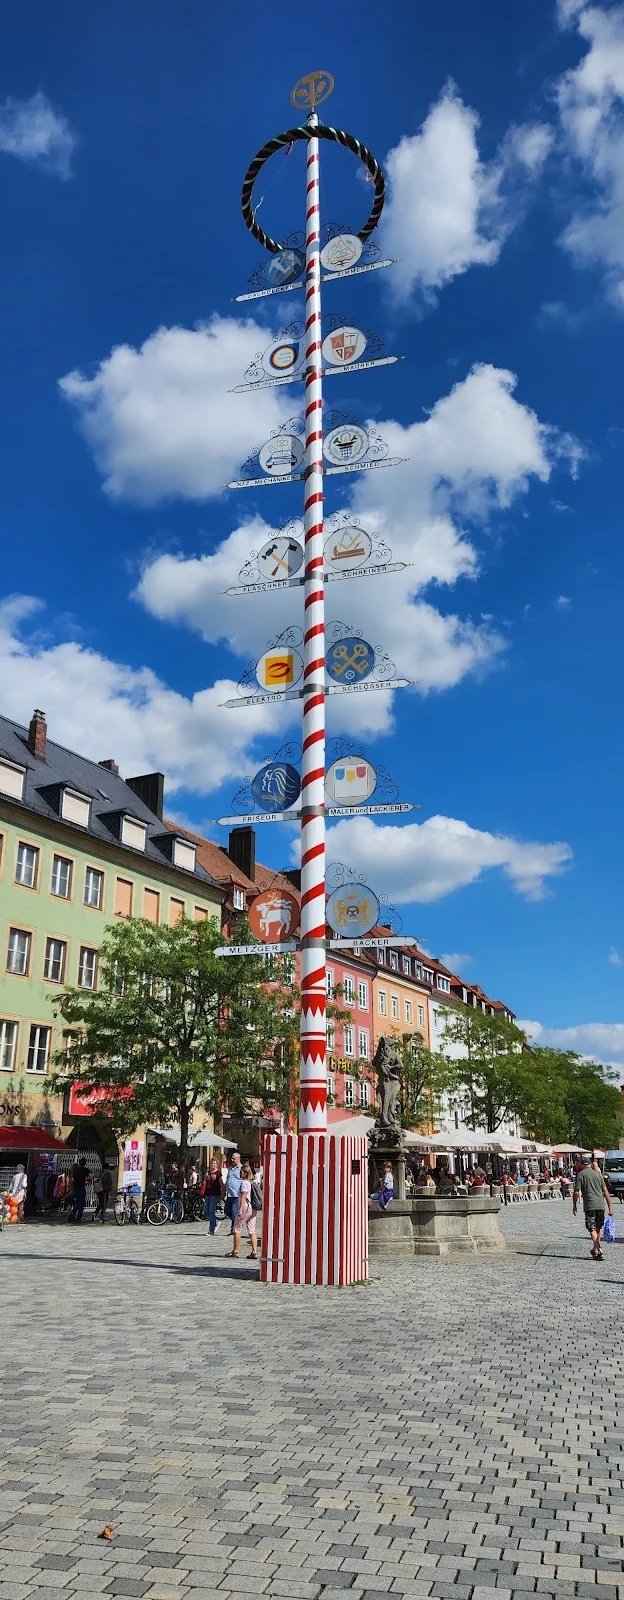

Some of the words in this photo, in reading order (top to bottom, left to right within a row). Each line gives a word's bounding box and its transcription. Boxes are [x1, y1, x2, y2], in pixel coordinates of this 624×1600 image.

[343, 361, 375, 371] MAURER
[345, 461, 380, 472] SCHMIED
[342, 566, 387, 577] SCHREINER
[243, 581, 288, 592] FLASCHNER
[246, 694, 281, 704] ELEKTRO
[330, 808, 354, 816] MALER
[356, 806, 368, 814] und
[369, 804, 409, 813] LACKIERER
[242, 814, 277, 823] FRISEUR
[229, 945, 278, 954] METZGER
